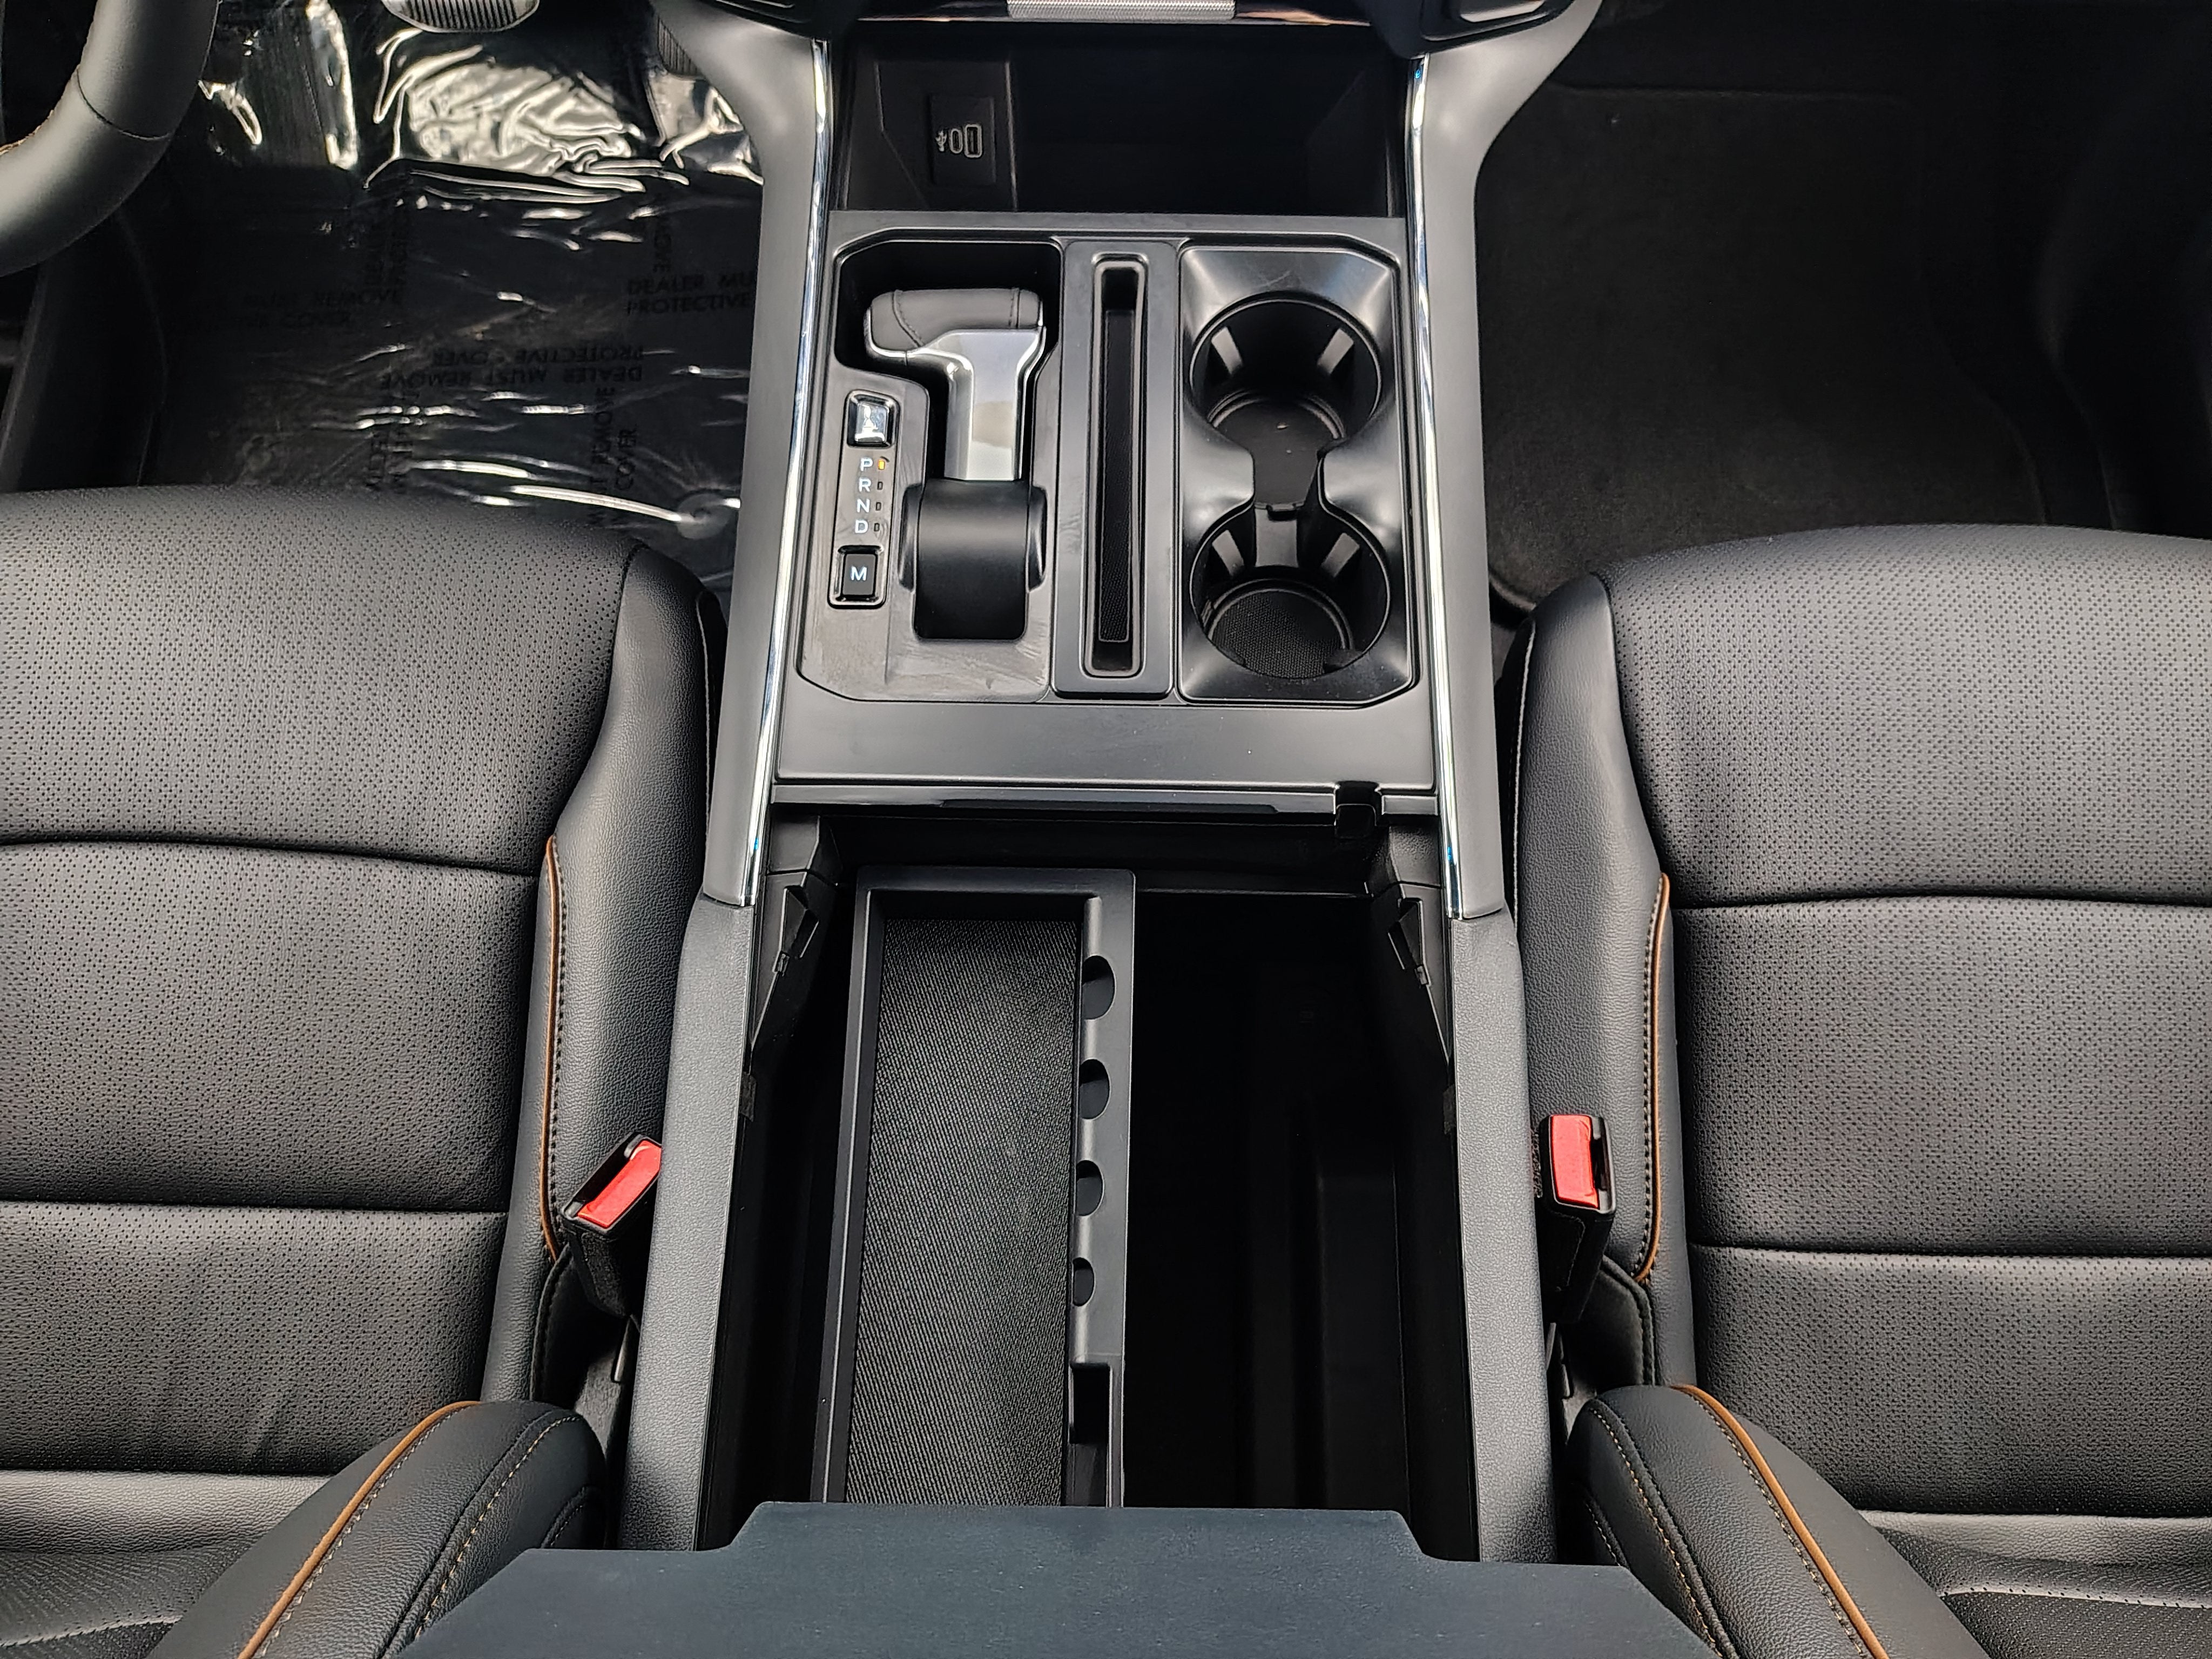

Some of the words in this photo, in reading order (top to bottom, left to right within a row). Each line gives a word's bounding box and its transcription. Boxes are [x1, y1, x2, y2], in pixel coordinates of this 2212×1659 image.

[627, 274, 704, 295] DEALER
[626, 292, 752, 315] PROTECTIVE
[514, 345, 644, 365] PROTECTIVE
[563, 365, 643, 385] DEALER
[860, 458, 873, 471] P
[858, 478, 872, 492] R
[857, 499, 871, 512] N
[855, 520, 868, 533] D
[850, 566, 867, 581] M
